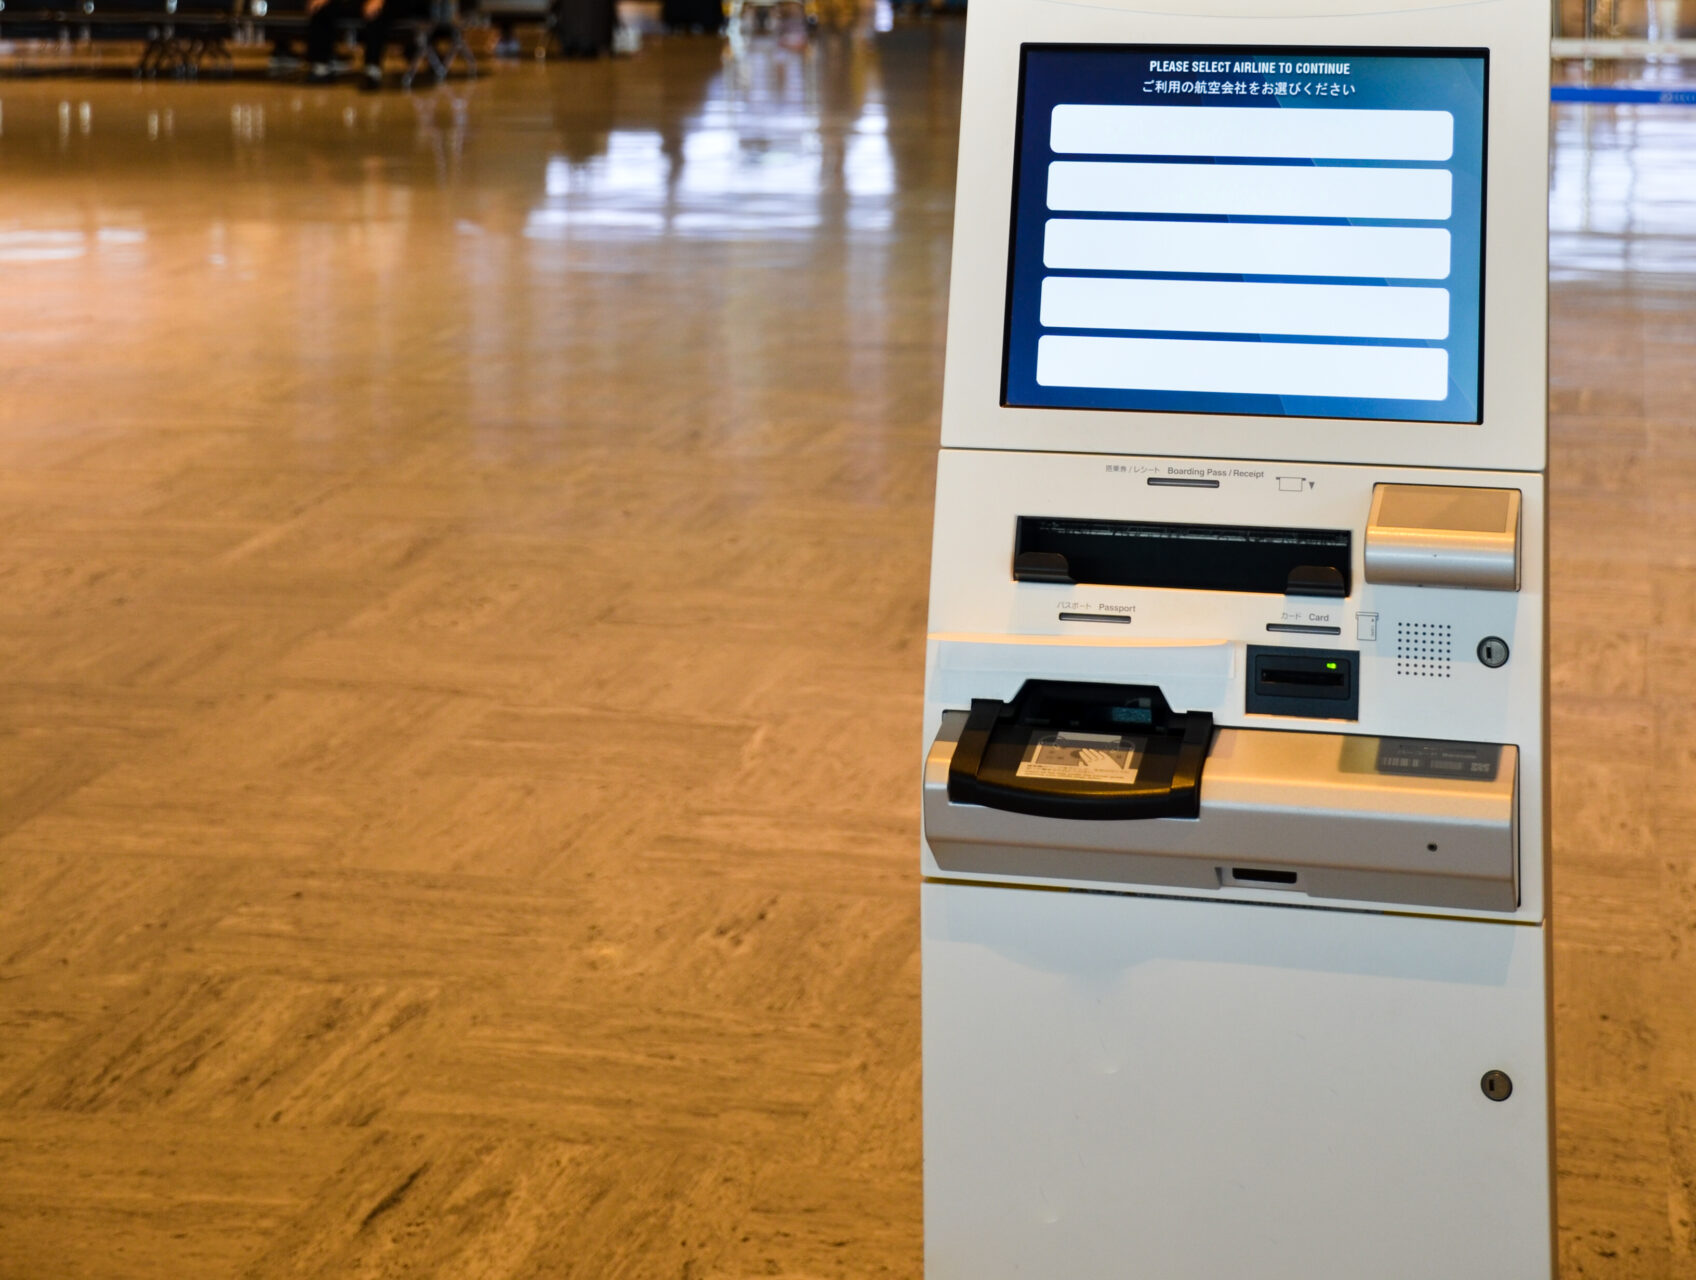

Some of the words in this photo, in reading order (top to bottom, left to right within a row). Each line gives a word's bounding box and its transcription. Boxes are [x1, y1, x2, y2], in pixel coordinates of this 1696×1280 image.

[1149, 60, 1190, 73] PLEASE
[1191, 61, 1232, 74] SELECT
[1233, 61, 1276, 74] AIRLINE
[1278, 62, 1293, 74] TO
[1295, 62, 1351, 75] CONTINUE
[1142, 79, 1356, 97] ご利用の航空会社をお選びください
[1167, 466, 1205, 477] Boarding
[1206, 468, 1227, 478] Pass
[1233, 469, 1265, 479] Receipt
[1098, 603, 1136, 613] Passport
[1281, 612, 1302, 621] カード
[1308, 613, 1330, 622] Card
